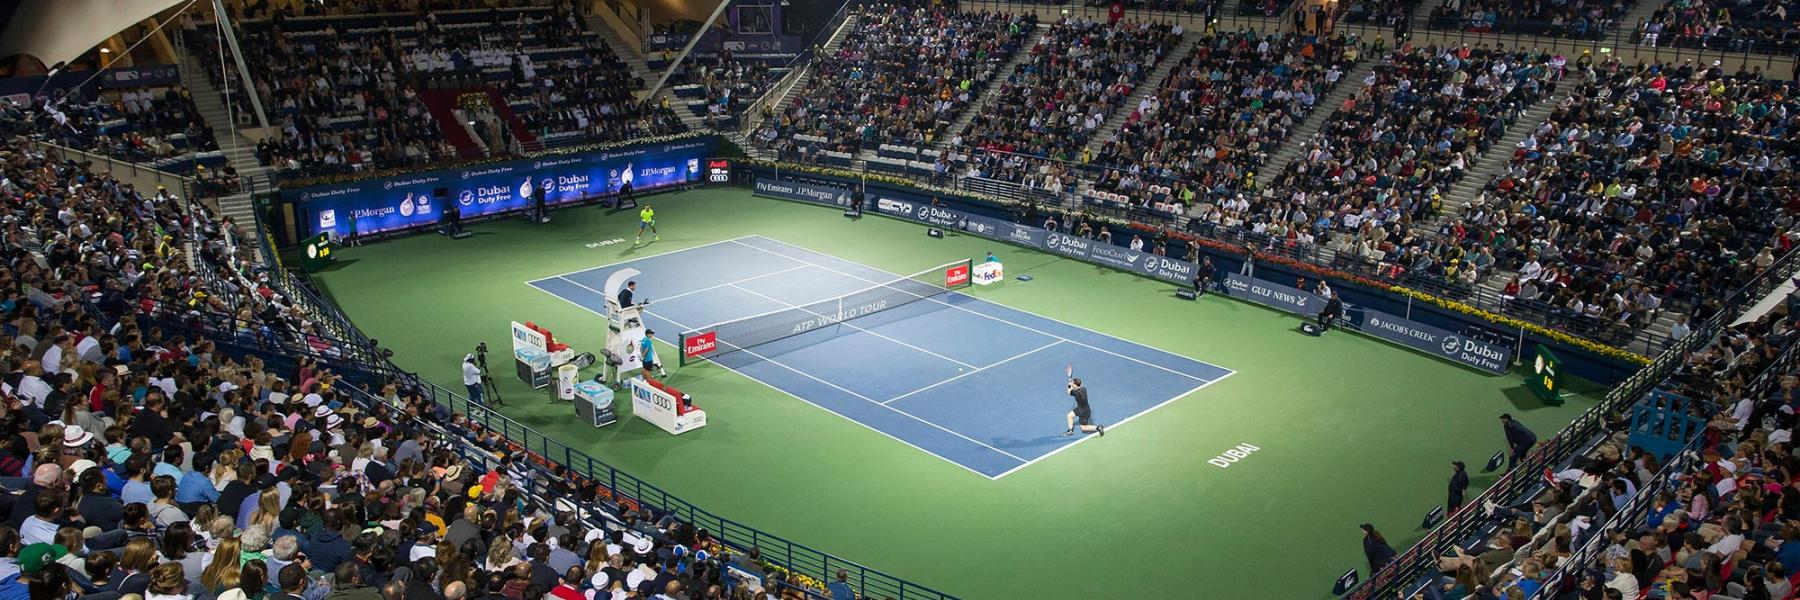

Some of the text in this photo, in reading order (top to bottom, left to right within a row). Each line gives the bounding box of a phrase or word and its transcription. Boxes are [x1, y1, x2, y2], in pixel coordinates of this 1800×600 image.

[640, 166, 676, 177] J.P.Morgan
[558, 174, 589, 185] Dubai
[478, 185, 510, 197] Dubai
[757, 182, 793, 194] Fly Emirates
[796, 187, 833, 200] J.P.Morgan
[478, 196, 496, 204] Duty
[585, 238, 626, 249] DUBAI
[1061, 236, 1088, 249] Dubai
[1060, 245, 1085, 256] Duty Free
[1160, 259, 1190, 273] Dubai
[984, 269, 1001, 281] FedEx
[1159, 268, 1187, 280] Duty Free
[1251, 285, 1296, 304] GULF NEWS
[793, 300, 887, 334] ATP WORLD TOUR
[1409, 328, 1434, 342] CREEK
[688, 341, 714, 353] Emirates
[1464, 340, 1504, 361] Dubai
[1461, 351, 1500, 370] Duty Free
[1208, 442, 1260, 468] DUBAI
